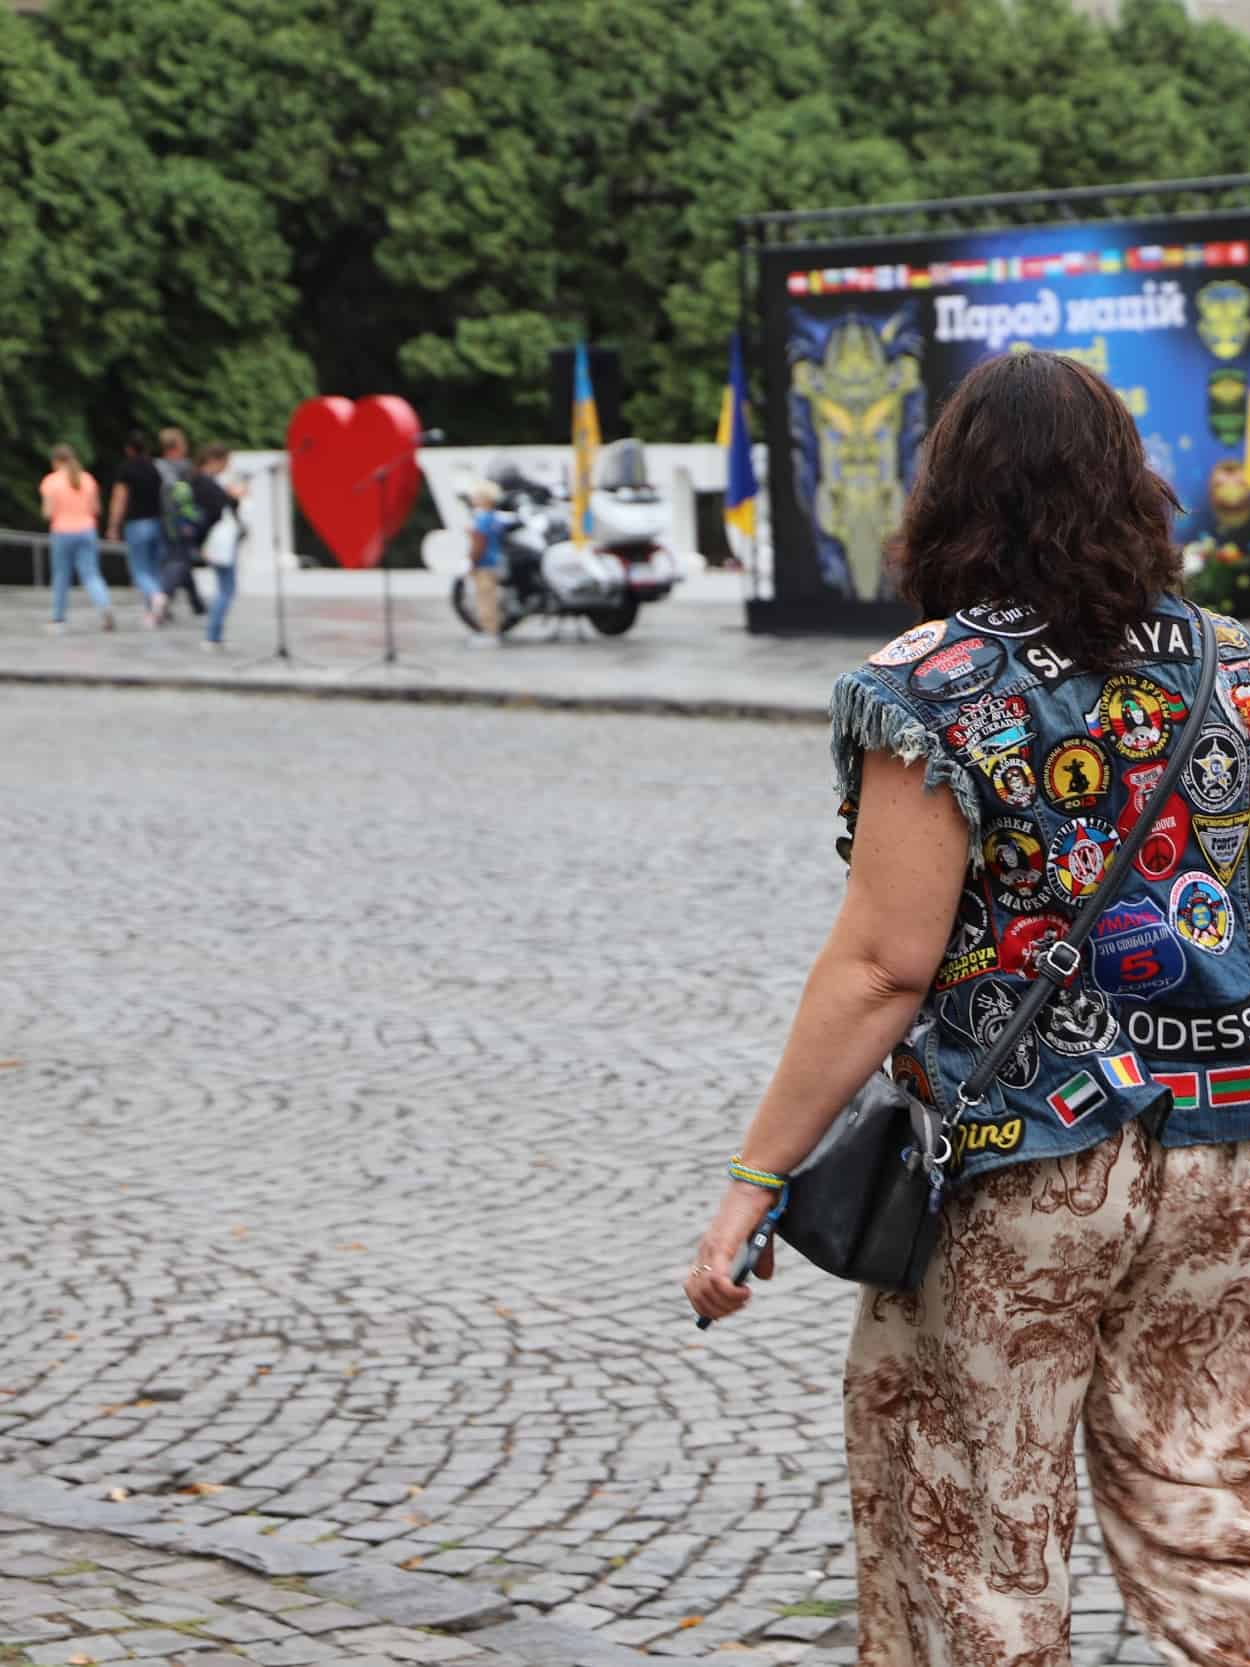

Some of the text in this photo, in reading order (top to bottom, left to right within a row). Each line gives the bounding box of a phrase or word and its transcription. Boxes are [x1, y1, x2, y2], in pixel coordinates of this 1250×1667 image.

[934, 281, 1187, 349] Парад націй
[1120, 948, 1161, 982] 5
